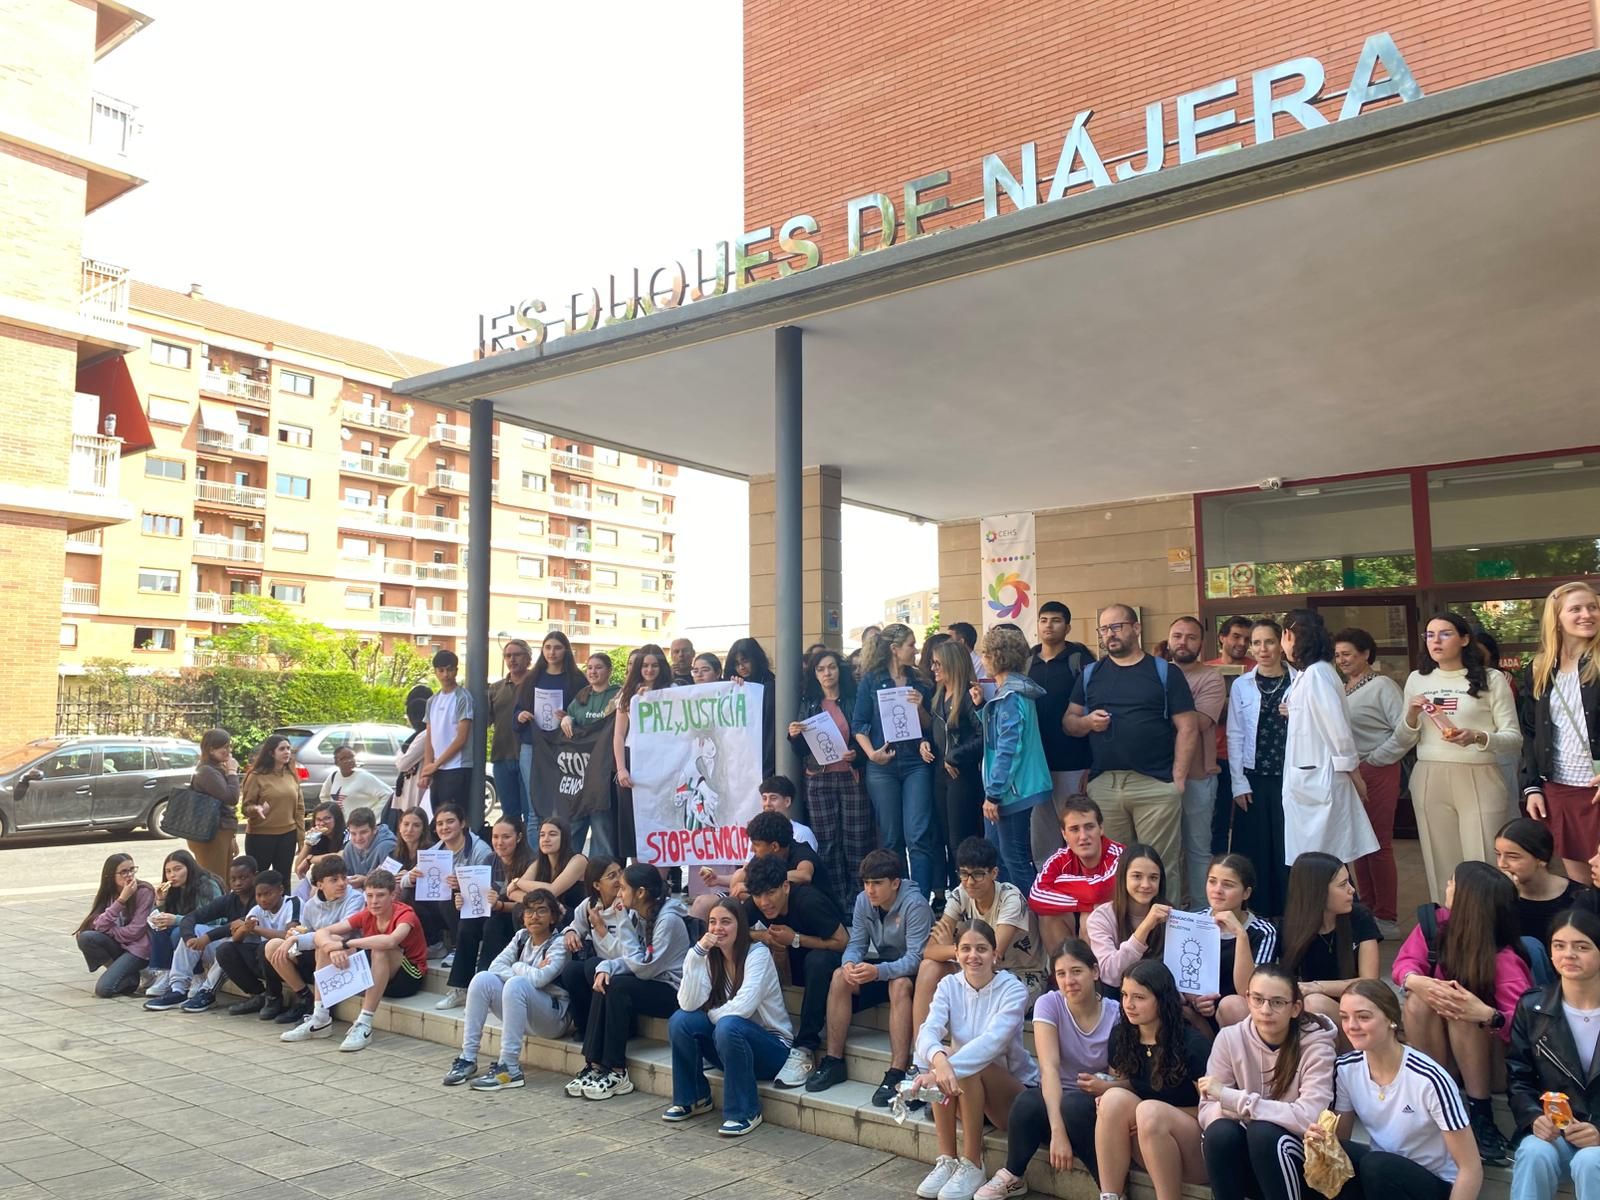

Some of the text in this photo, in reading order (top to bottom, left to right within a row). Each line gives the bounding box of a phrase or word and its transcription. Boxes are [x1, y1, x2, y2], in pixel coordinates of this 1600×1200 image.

[474, 31, 1424, 360] IES DUQUES DE NÁJERA
[638, 699, 673, 733] PAZ
[557, 751, 590, 776] STOP
[646, 825, 749, 864] STOP-GENOCID
